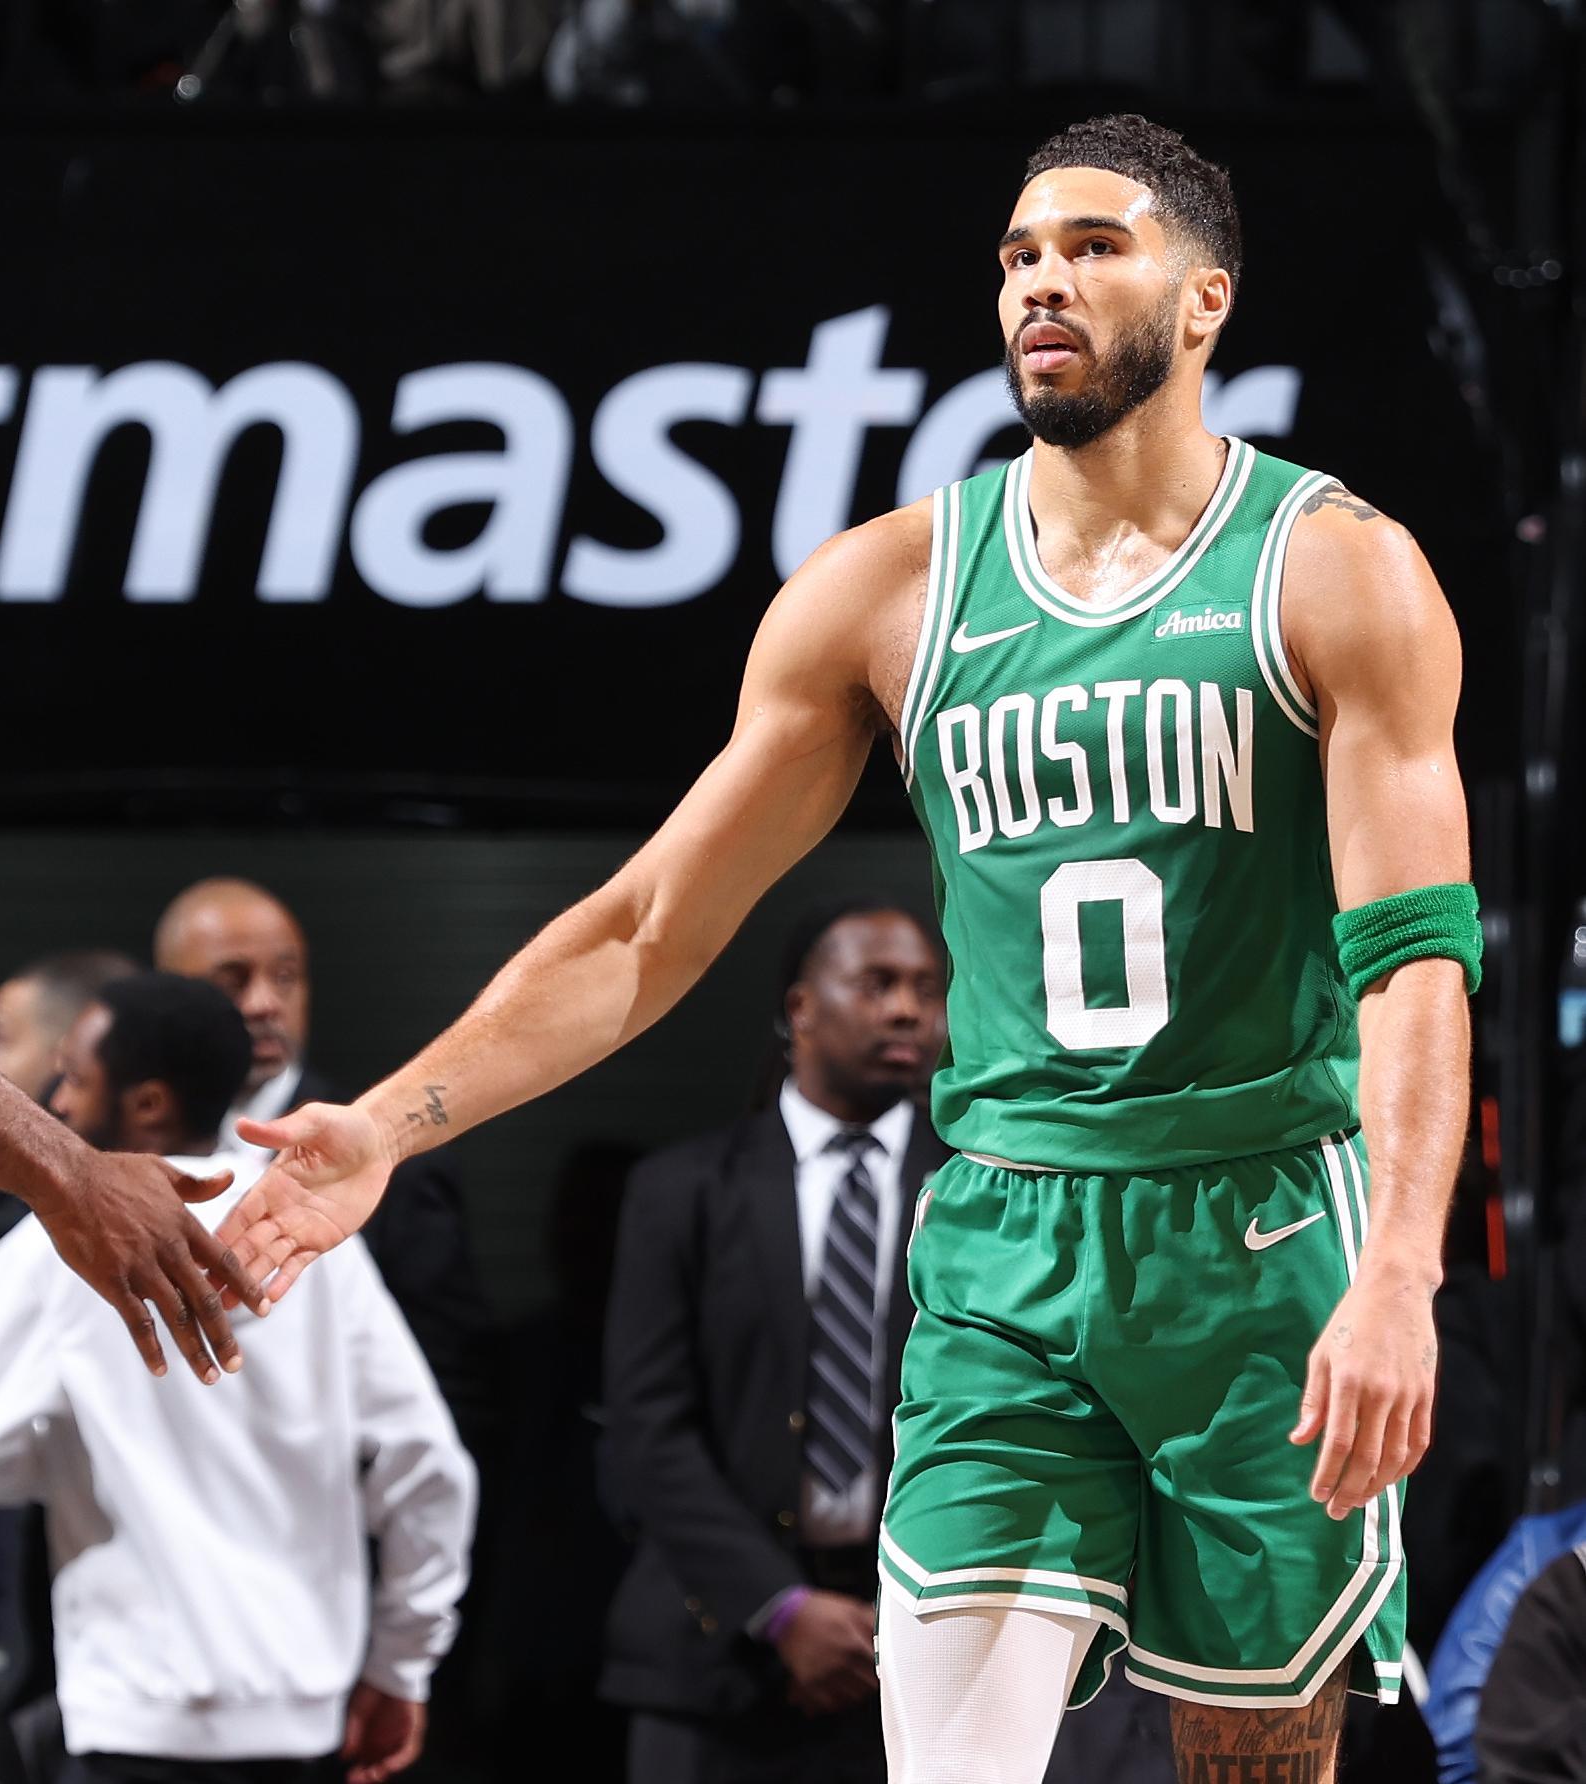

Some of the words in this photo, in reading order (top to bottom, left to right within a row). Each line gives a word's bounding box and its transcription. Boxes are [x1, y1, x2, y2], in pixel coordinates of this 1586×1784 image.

[1154, 607, 1242, 638] Amica
[936, 678, 1254, 855] BOSTON
[1040, 858, 1169, 1050] 0
